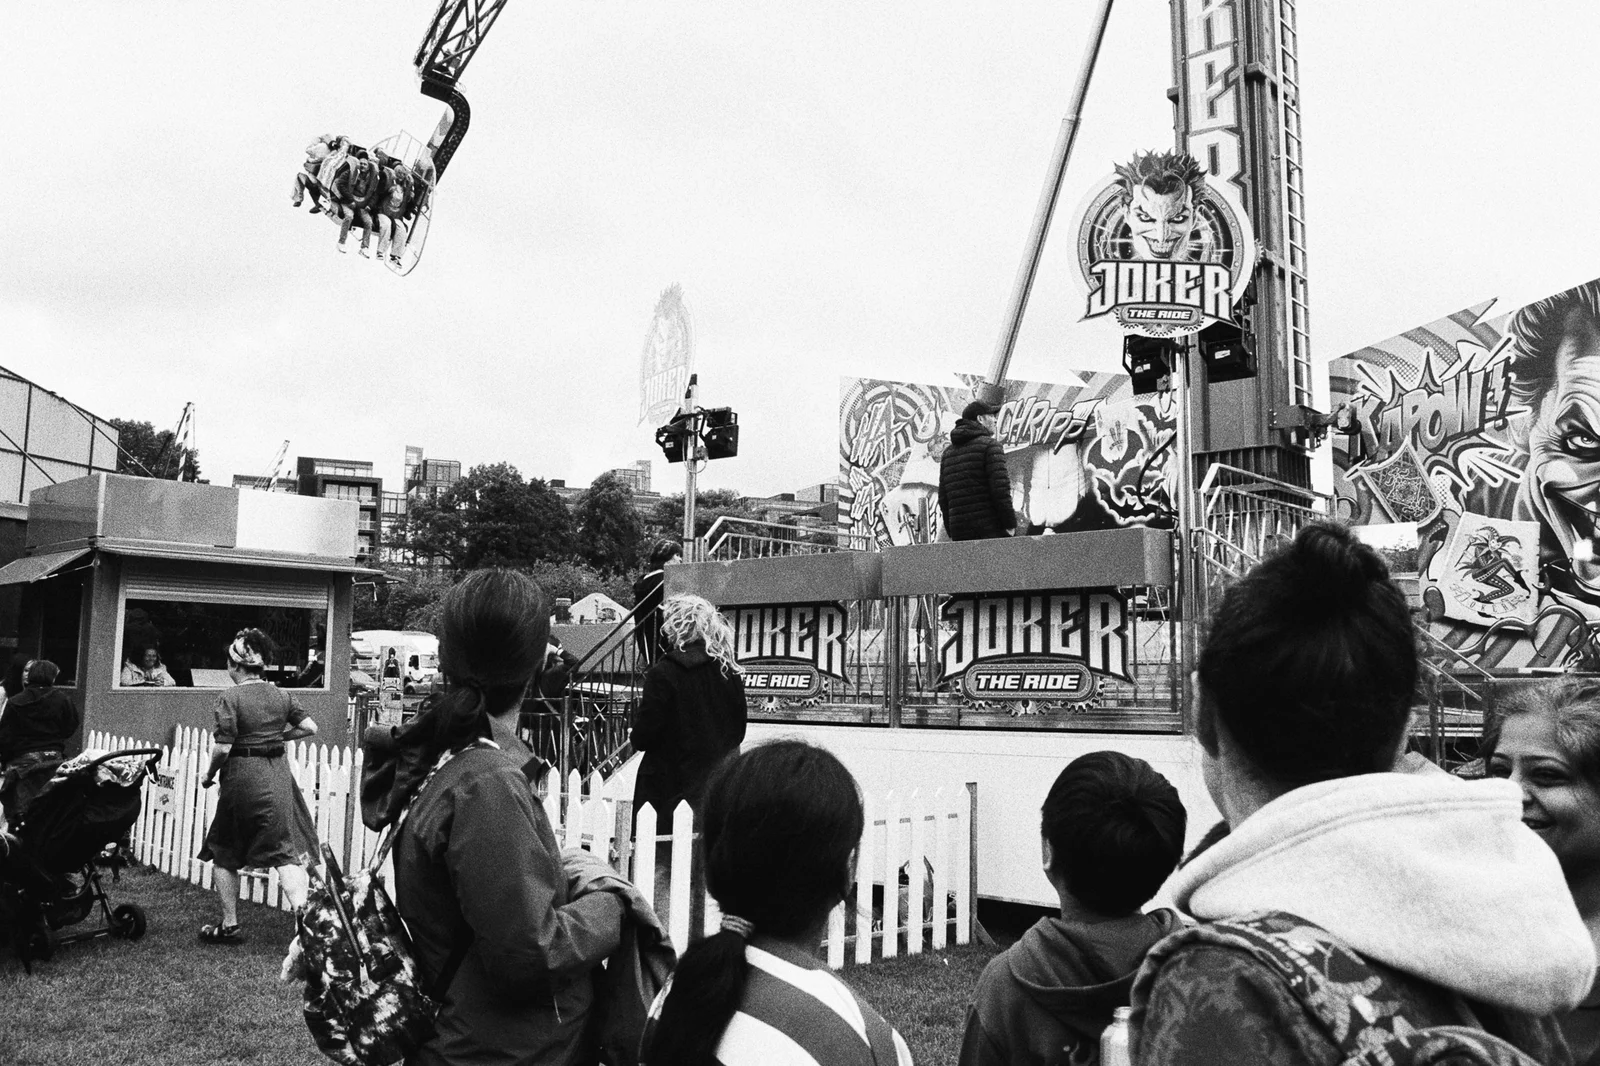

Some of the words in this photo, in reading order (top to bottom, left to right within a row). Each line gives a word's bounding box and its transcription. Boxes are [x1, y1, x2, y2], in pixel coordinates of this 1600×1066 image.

[1086, 261, 1235, 321] JOKER
[1128, 308, 1157, 320] THE
[1157, 310, 1192, 321] RIDE
[850, 394, 907, 468] HA
[943, 594, 1126, 677] JOKER
[769, 673, 812, 688] RIDE
[976, 673, 1023, 690] THE
[1022, 673, 1080, 690] RIDE
